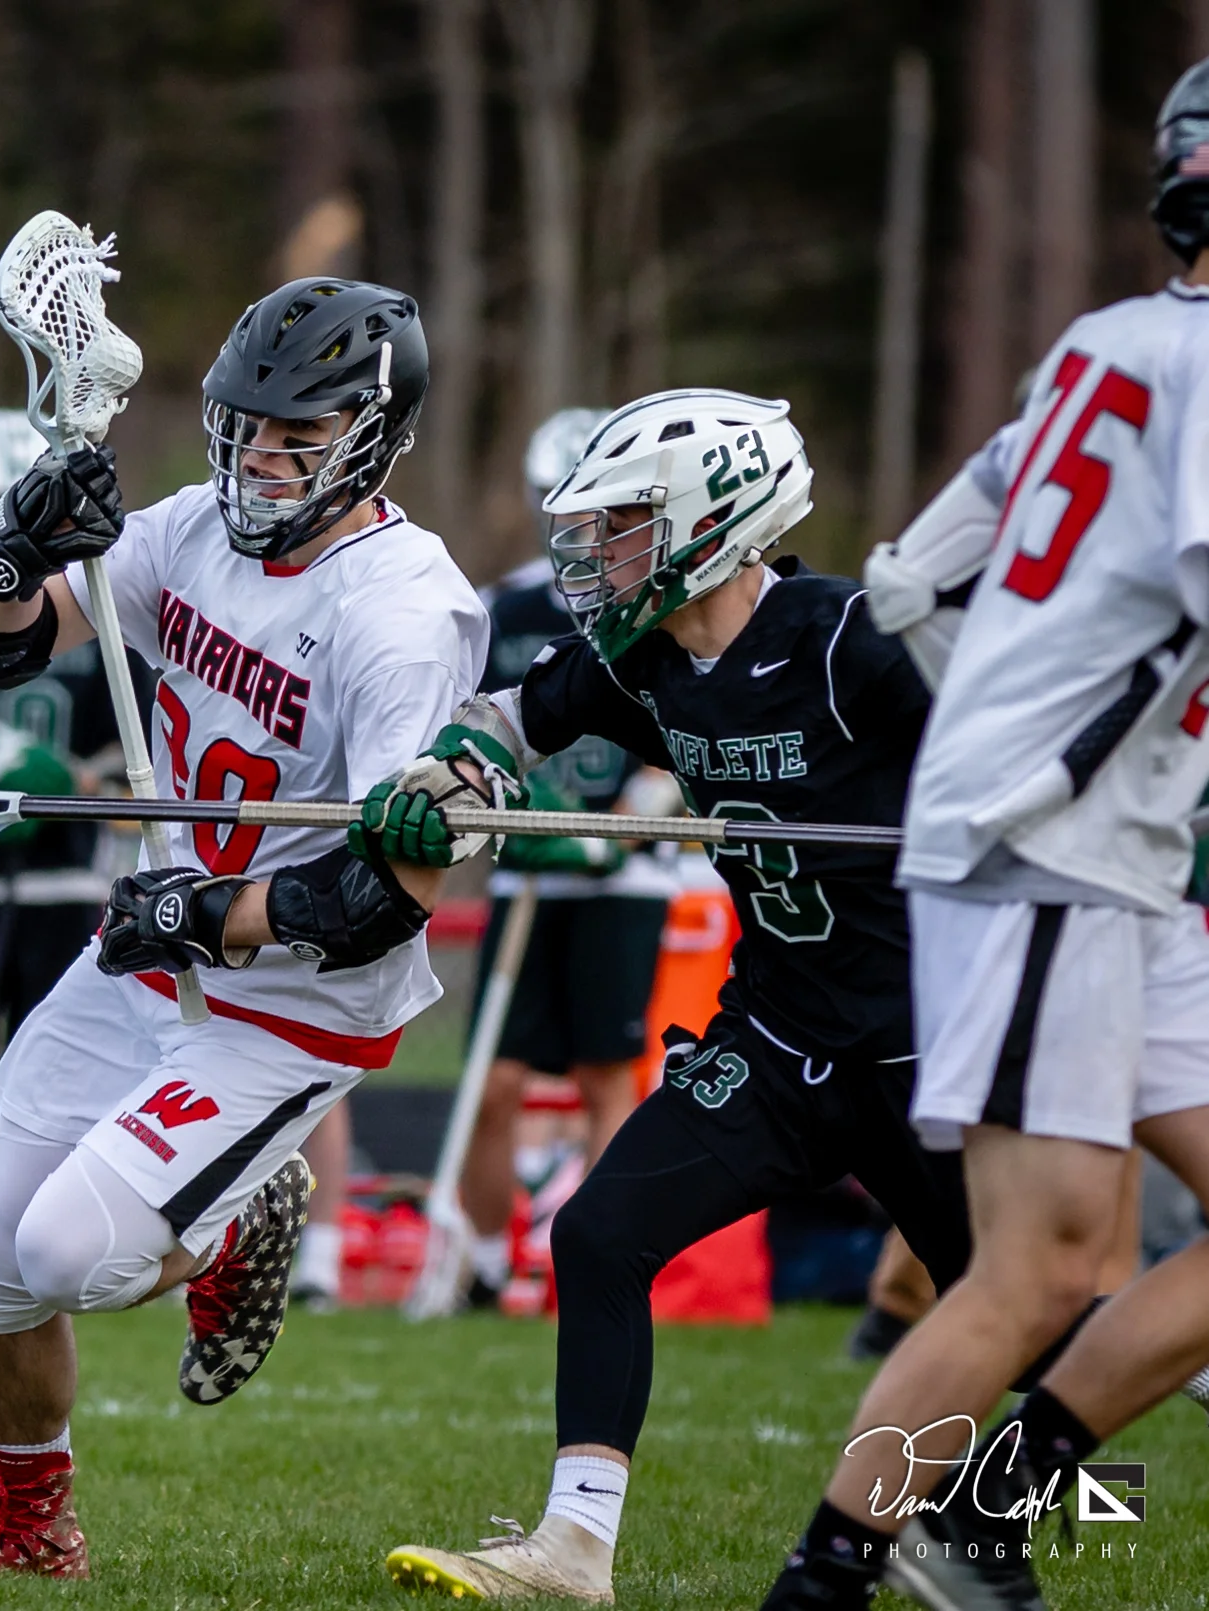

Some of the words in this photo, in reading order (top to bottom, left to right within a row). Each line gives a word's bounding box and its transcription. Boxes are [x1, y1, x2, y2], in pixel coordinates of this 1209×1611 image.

[702, 430, 770, 503] 23
[695, 543, 741, 583] WAYNFLETE
[639, 690, 808, 782] NFLETE
[114, 1110, 179, 1165] LACROSSE
